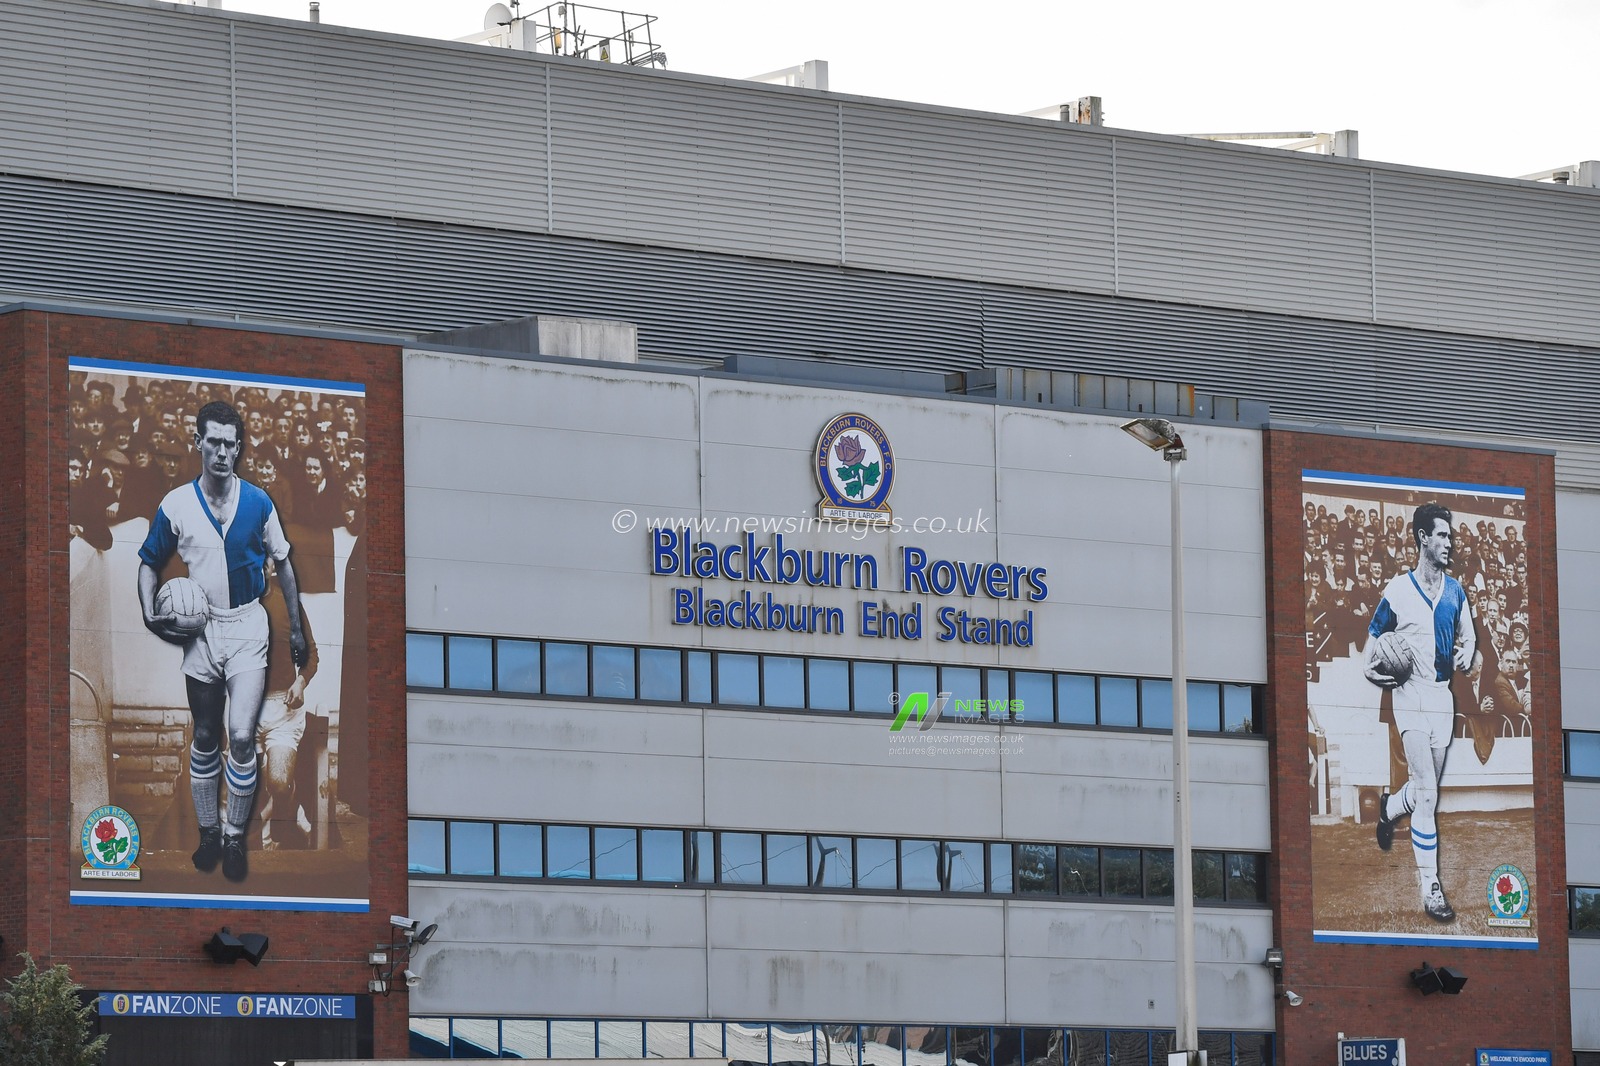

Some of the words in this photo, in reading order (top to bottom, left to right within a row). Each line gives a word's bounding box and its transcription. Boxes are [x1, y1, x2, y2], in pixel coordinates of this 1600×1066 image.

[820, 418, 851, 467] BLACKBURN
[855, 418, 885, 444] ROVERS
[829, 509, 846, 518] ARTE
[651, 526, 878, 590] Blackburn
[901, 545, 1048, 602] Rovers
[672, 586, 845, 635] Blackburn
[859, 600, 923, 640] End
[937, 606, 1034, 648] Stand
[82, 807, 110, 855] BLACKBURN
[132, 995, 222, 1015] FANZONE
[256, 997, 343, 1016] FANZONE
[1343, 1044, 1387, 1060] BLUES
